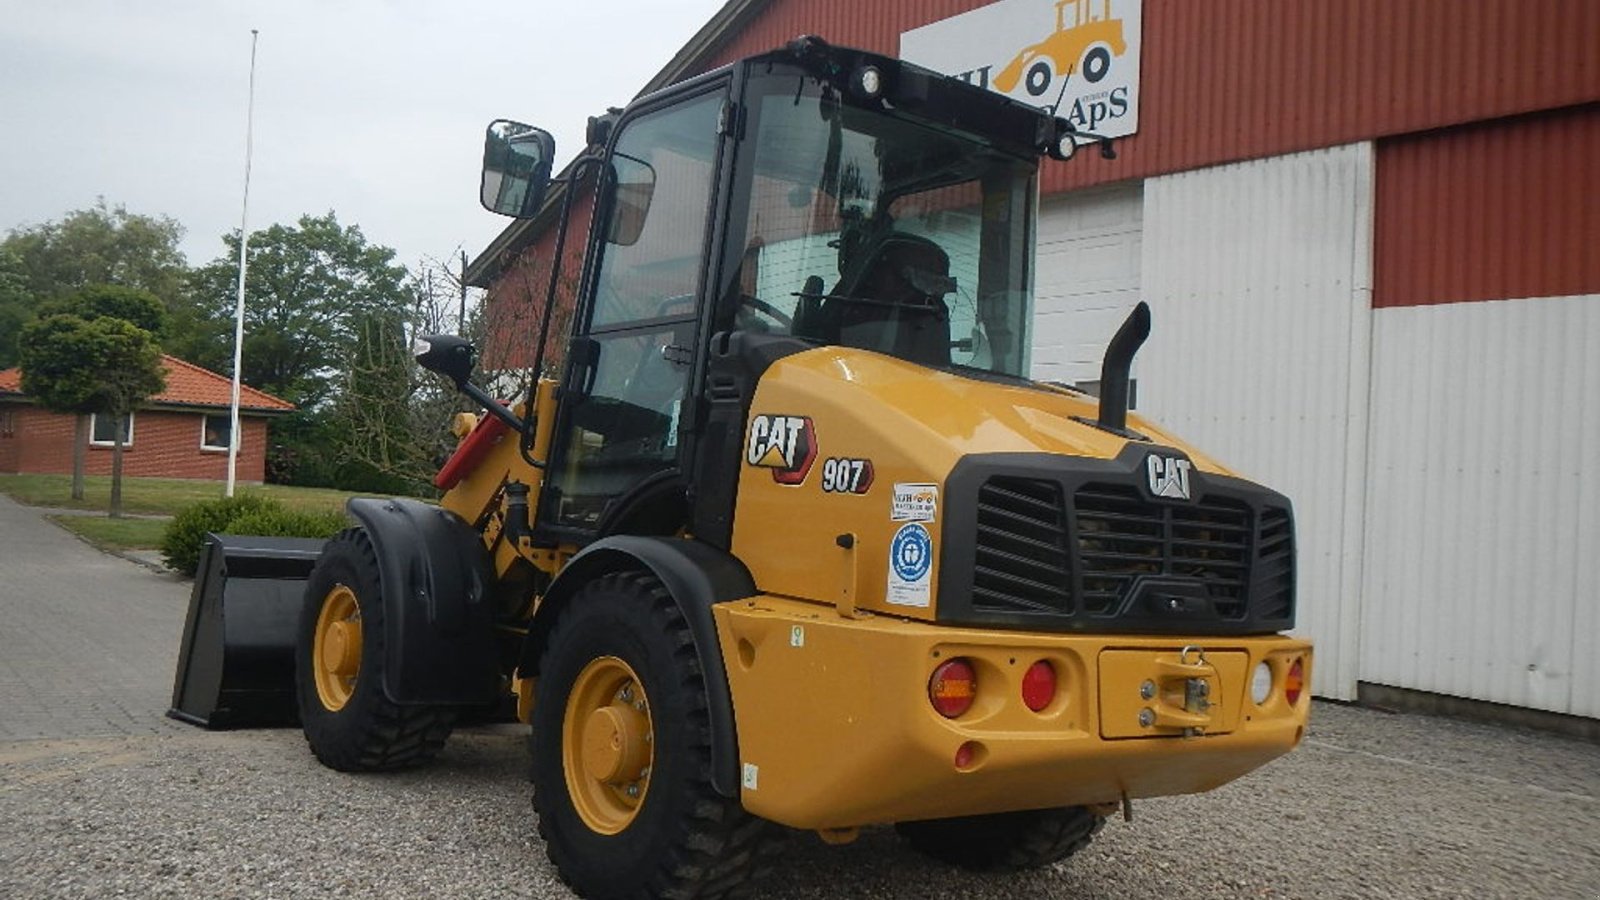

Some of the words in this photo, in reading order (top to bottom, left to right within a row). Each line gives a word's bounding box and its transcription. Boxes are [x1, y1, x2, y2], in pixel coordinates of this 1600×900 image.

[1069, 87, 1128, 131] ApS
[748, 415, 804, 468] CAT
[823, 459, 864, 492] 907
[1148, 454, 1191, 499] CAT
